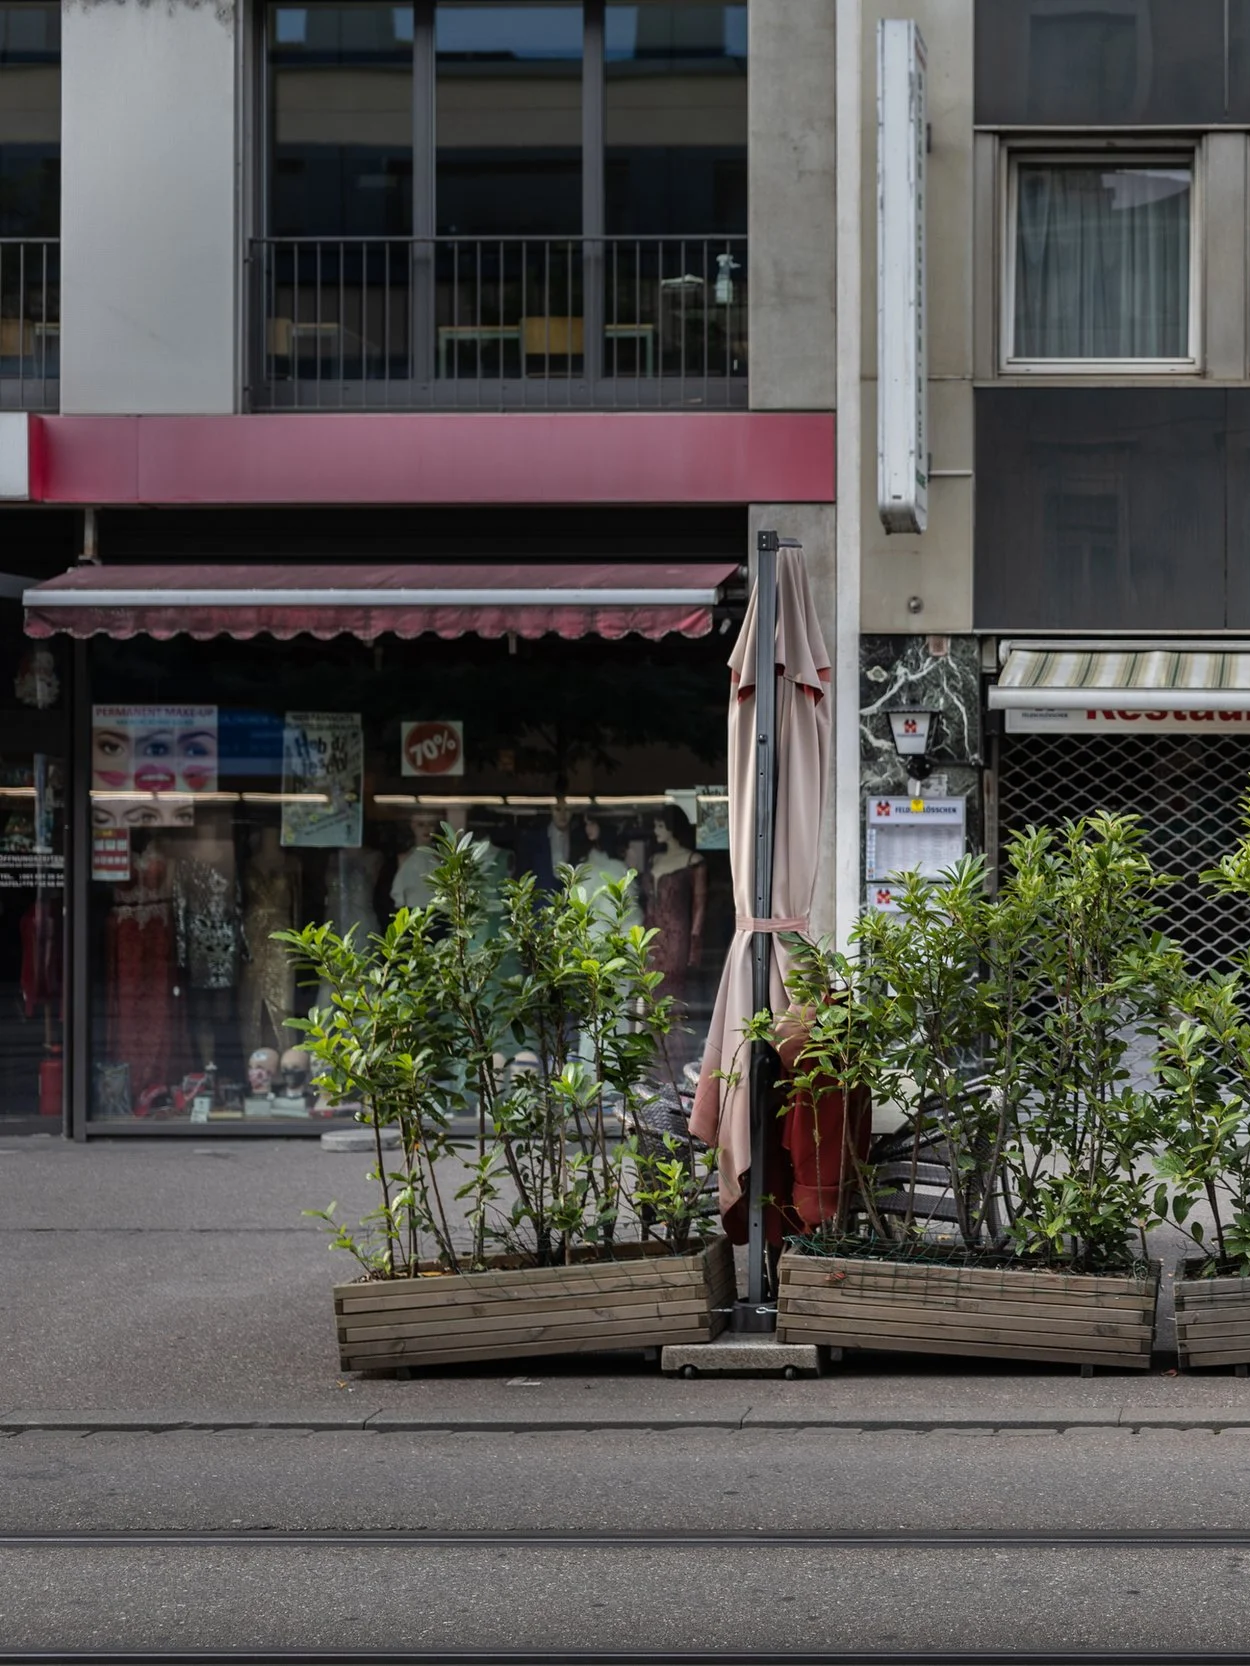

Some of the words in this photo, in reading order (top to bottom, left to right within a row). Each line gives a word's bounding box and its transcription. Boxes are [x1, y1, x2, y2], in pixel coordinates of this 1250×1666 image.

[95, 707, 162, 717] PERMANENT
[164, 707, 215, 717] MAKE-UP
[409, 729, 456, 766] 70%
[895, 805, 957, 814] FELDLÖSSCHEN
